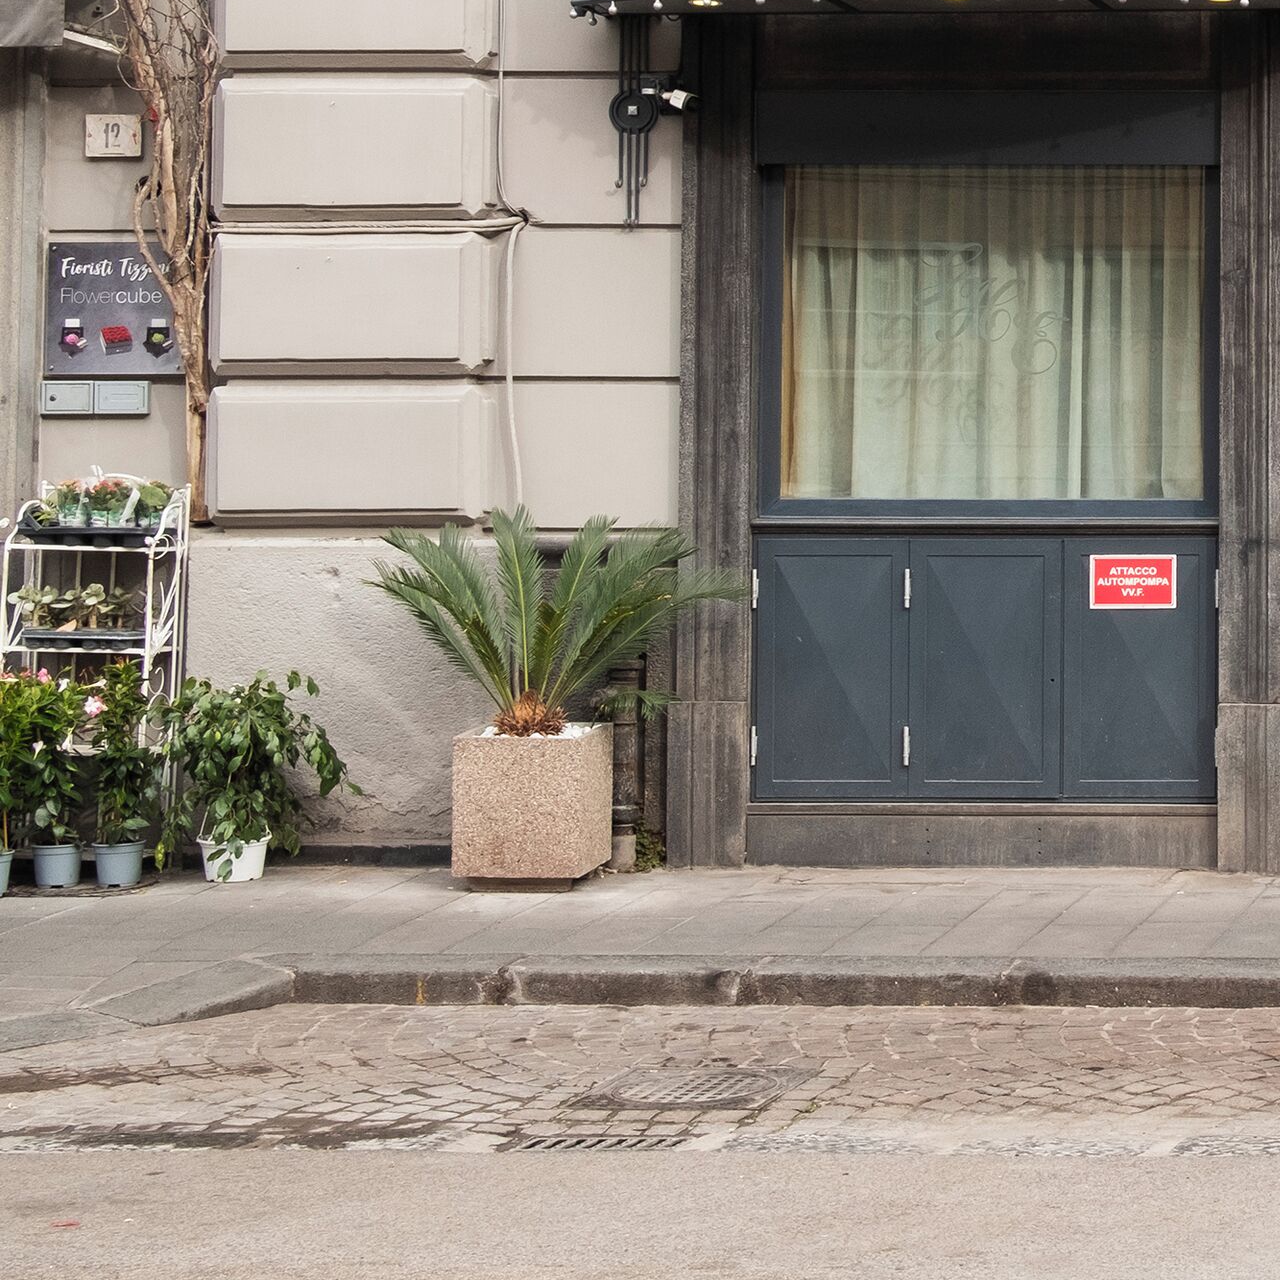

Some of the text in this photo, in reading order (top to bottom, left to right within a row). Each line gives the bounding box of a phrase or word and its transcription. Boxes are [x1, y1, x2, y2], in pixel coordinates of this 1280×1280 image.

[103, 122, 121, 149] 12
[61, 257, 114, 278] Fioristi
[60, 287, 163, 304] Flowercube
[1109, 566, 1158, 575] ATTACCO
[1097, 577, 1170, 586] AUTOMPOMPA
